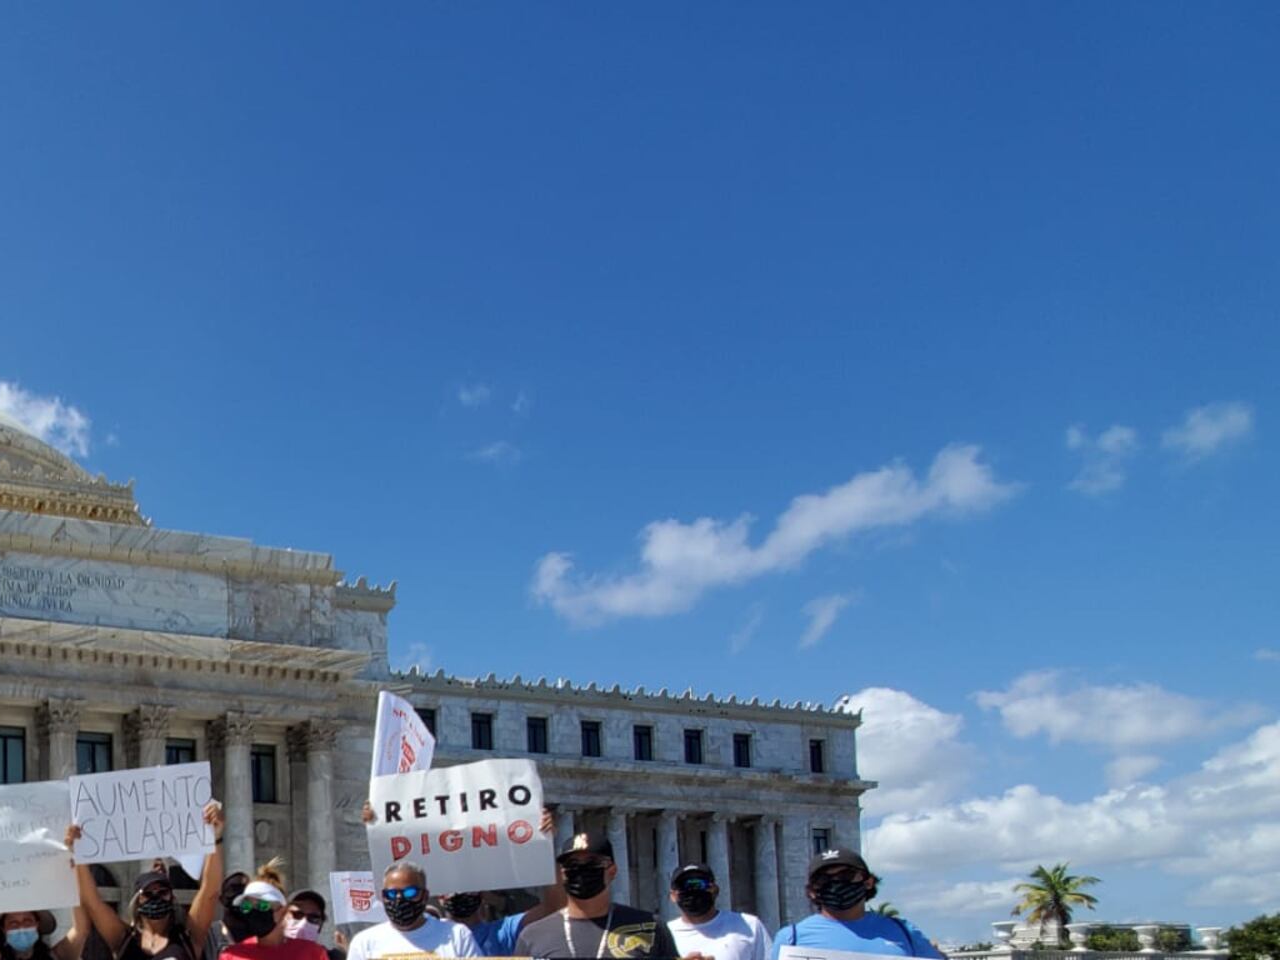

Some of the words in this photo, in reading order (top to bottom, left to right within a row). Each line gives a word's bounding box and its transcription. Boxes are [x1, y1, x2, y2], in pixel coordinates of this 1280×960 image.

[75, 774, 212, 816] AUMENTO
[385, 784, 532, 823] RETIRO
[81, 812, 215, 858] SALARIAL
[391, 819, 534, 861] DIGNO
